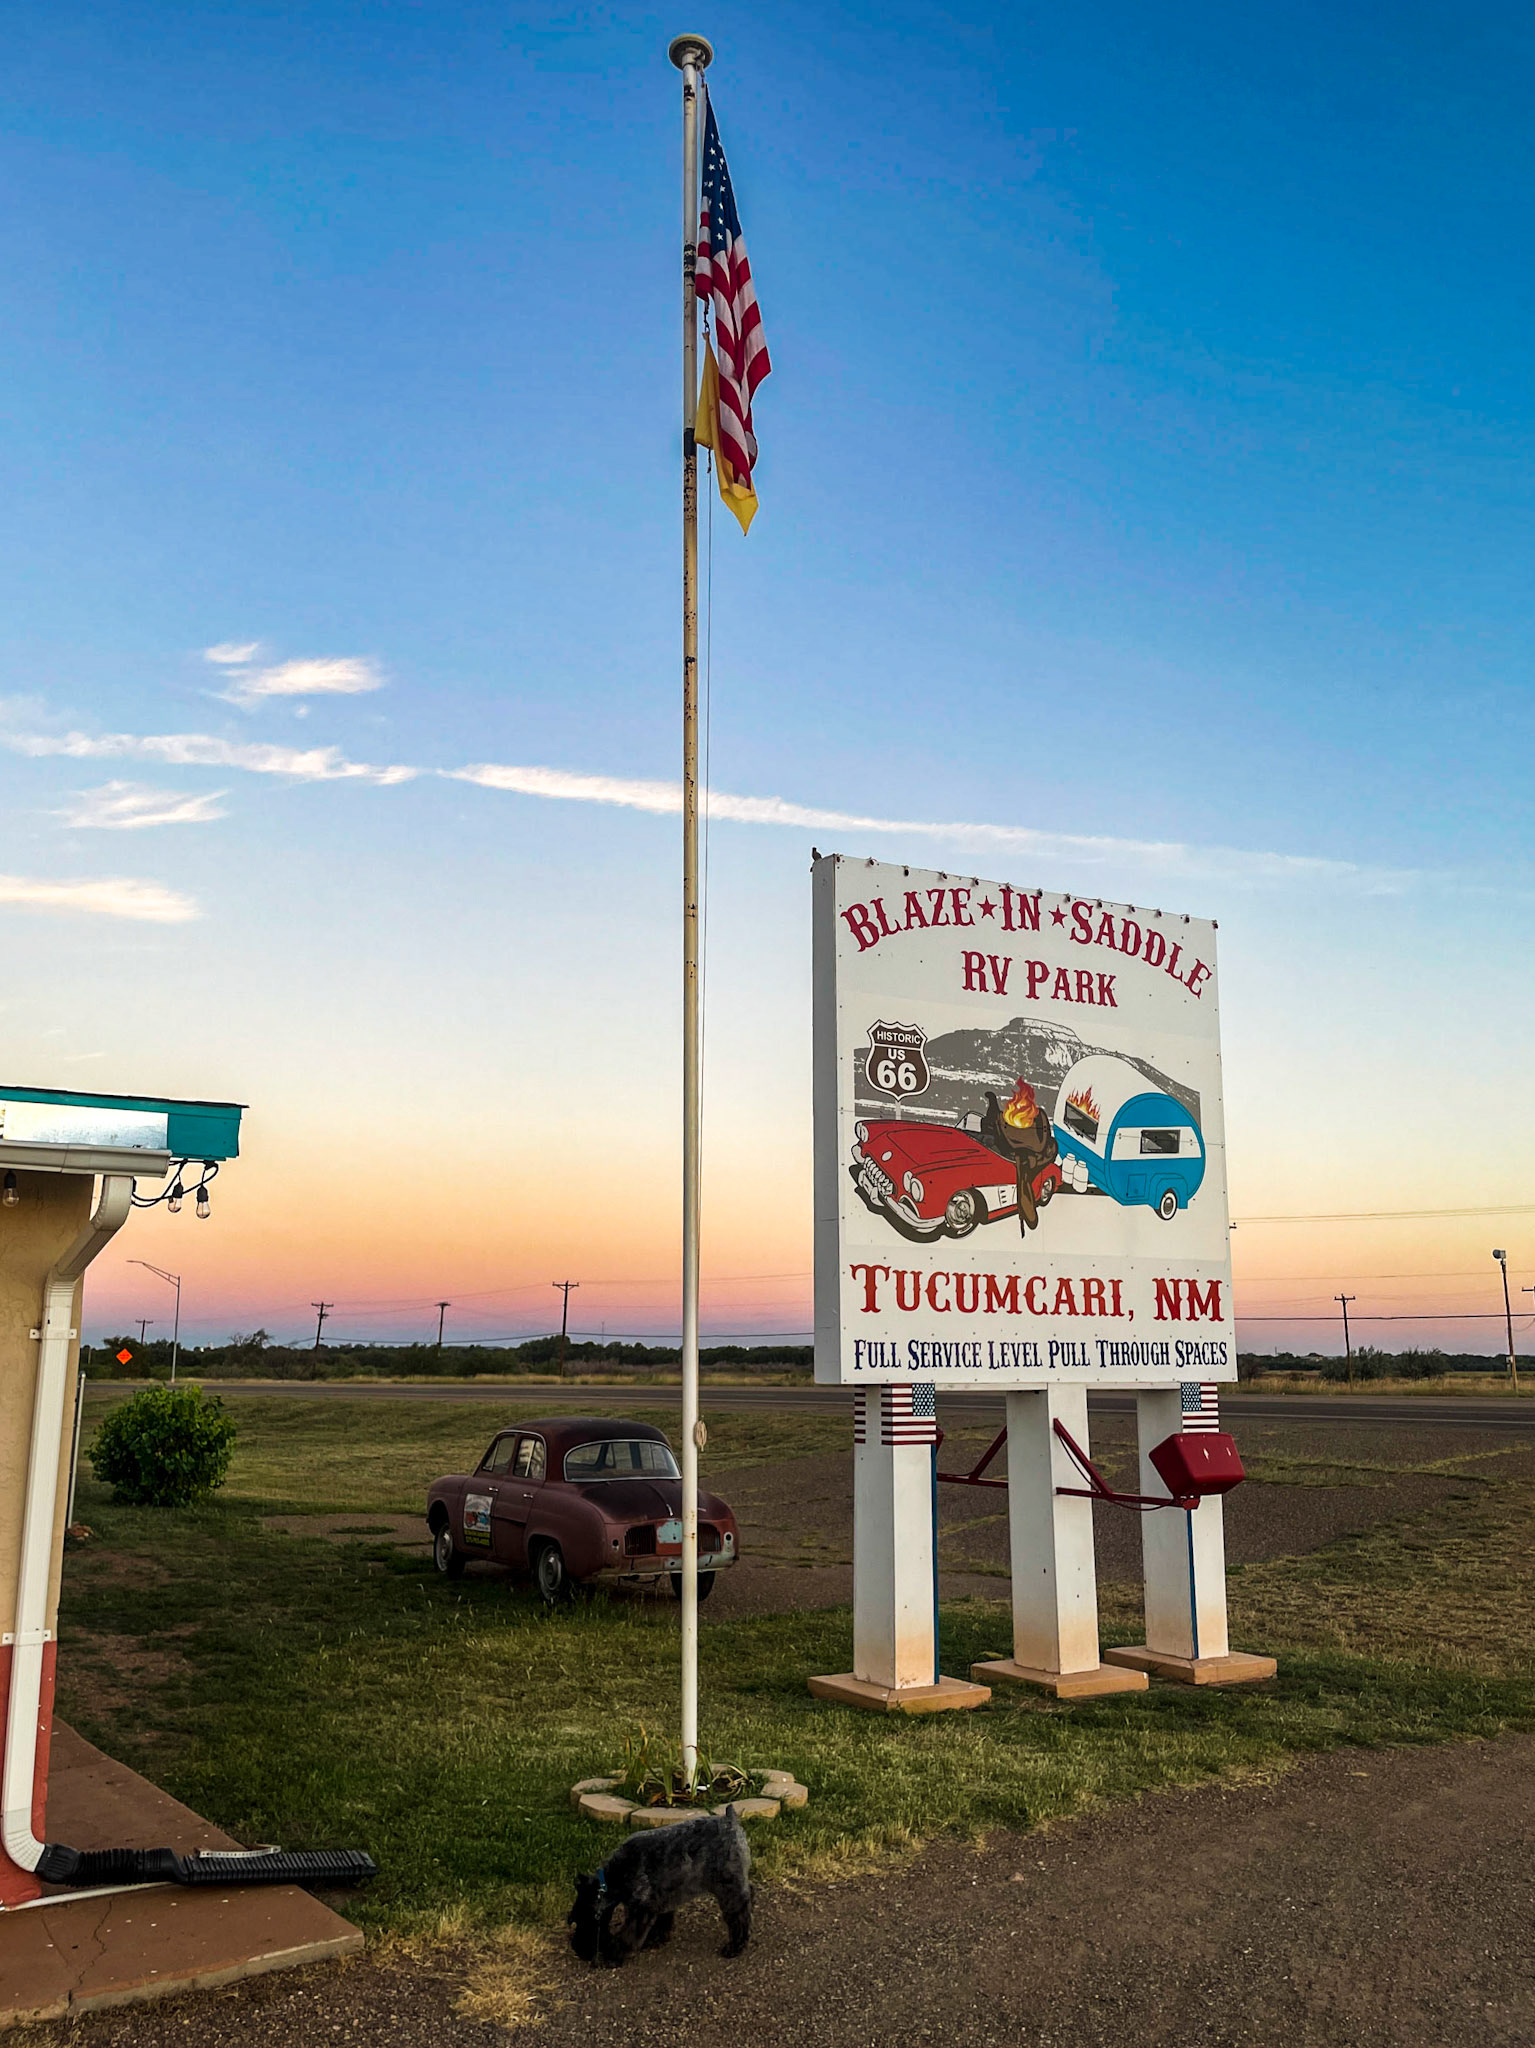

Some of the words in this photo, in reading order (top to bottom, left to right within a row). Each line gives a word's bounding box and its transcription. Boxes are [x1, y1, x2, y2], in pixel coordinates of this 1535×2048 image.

[840, 887, 976, 953] BLAZE
[999, 886, 1041, 932] IN
[1069, 900, 1213, 999] SADDLE
[960, 950, 1013, 996] RV
[1024, 959, 1118, 1008] PARK
[877, 1030, 921, 1045] HISTORIC
[887, 1048, 906, 1061] US
[877, 1059, 917, 1091] 66
[849, 1263, 1134, 1322] TUCUMCARI,
[1152, 1277, 1225, 1322] NM
[853, 1339, 902, 1370] FULL
[907, 1339, 983, 1371] SERVICE
[987, 1340, 1043, 1370] LEVEL
[1047, 1339, 1091, 1369] PULL
[1095, 1339, 1171, 1368] THROUGH
[1174, 1339, 1228, 1368] SPACES
